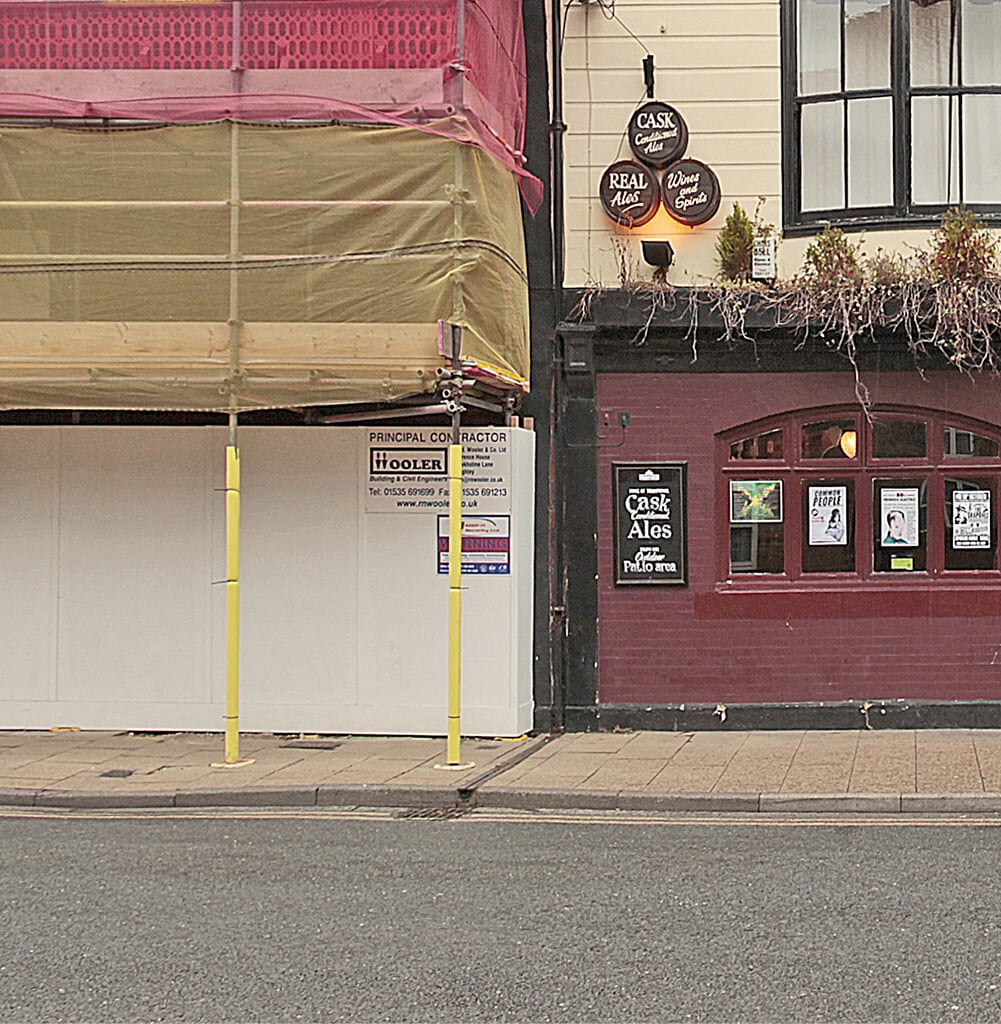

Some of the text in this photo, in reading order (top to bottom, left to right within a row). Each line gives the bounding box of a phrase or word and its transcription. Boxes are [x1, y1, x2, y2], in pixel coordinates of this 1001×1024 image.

[637, 112, 676, 129] CASK
[635, 127, 678, 146] Conditioned
[643, 141, 664, 154] Ales
[609, 172, 649, 190] REAL
[667, 170, 700, 190] Wines
[679, 183, 699, 197] and
[610, 190, 641, 208] Ales
[674, 192, 708, 211] Spirits
[369, 432, 507, 443] PRINCIPAL CONRACTOR
[375, 452, 443, 470] WOOLER
[369, 487, 382, 496] Tel:
[383, 487, 406, 496] 01535
[481, 488, 508, 496] 691213
[625, 493, 671, 513] Cask
[813, 495, 842, 507] PEOPLE
[627, 520, 673, 539] Ales
[440, 539, 508, 549] WRNING
[623, 560, 677, 573] Patio area
